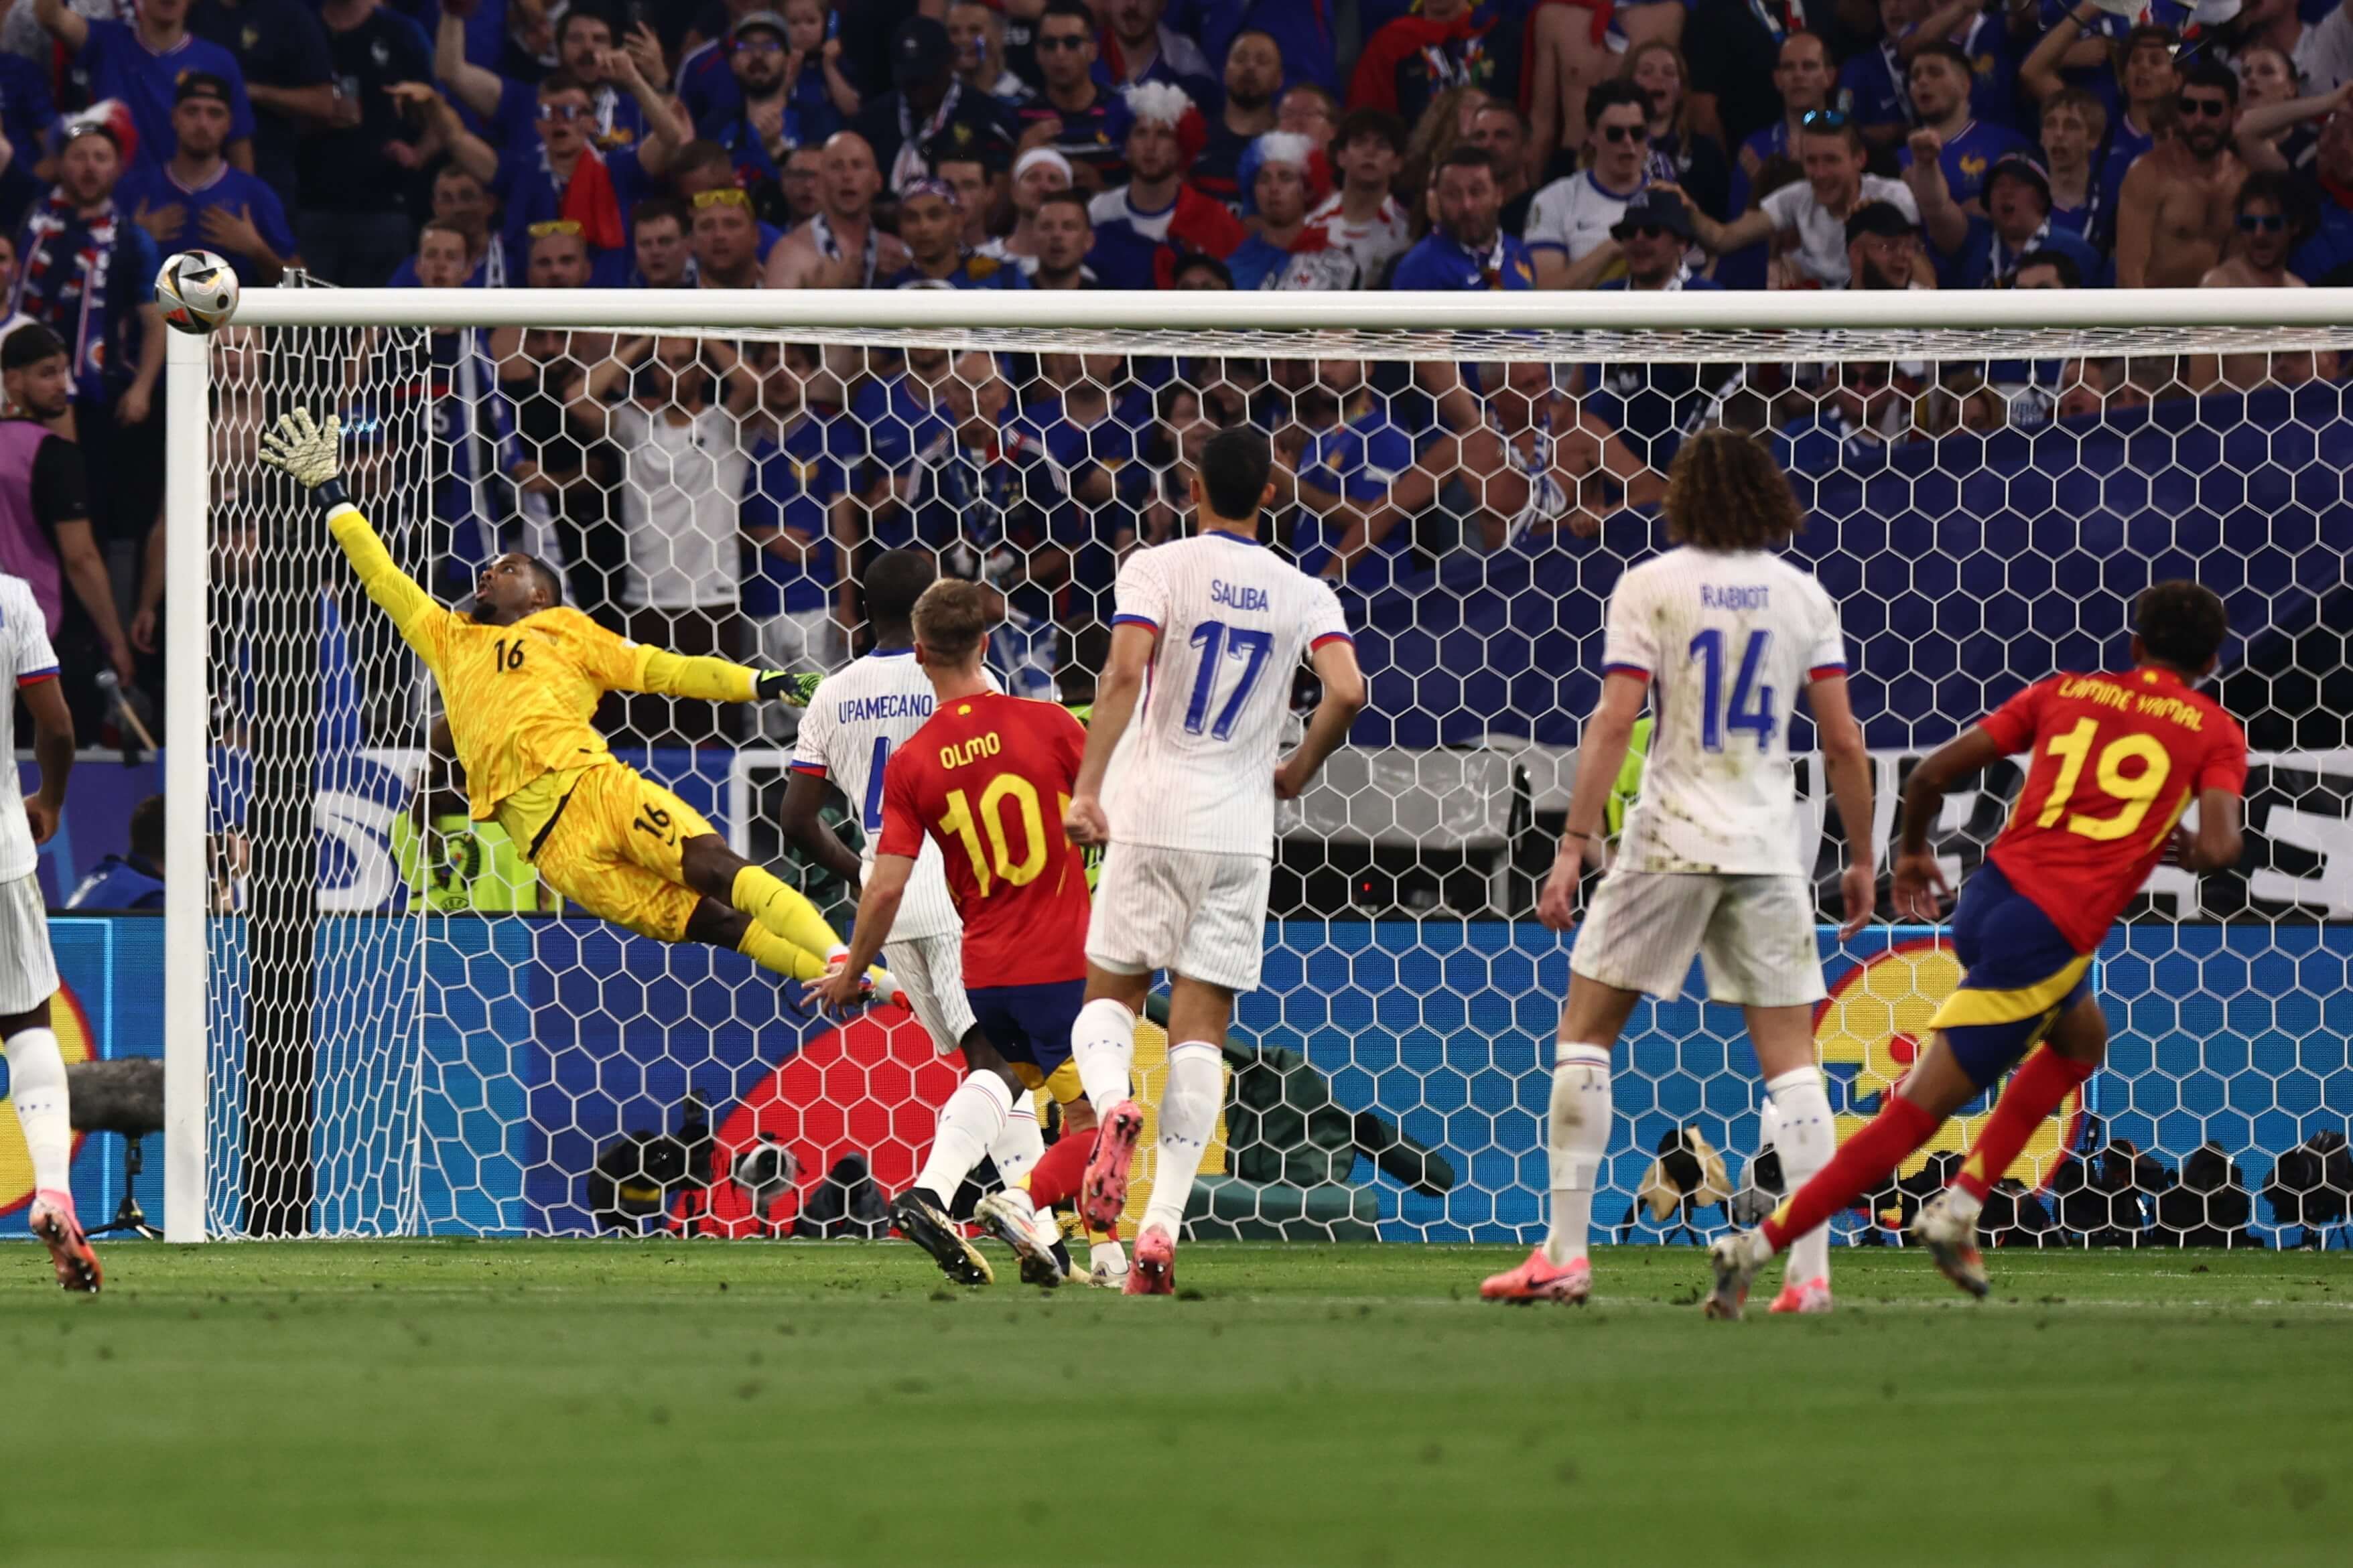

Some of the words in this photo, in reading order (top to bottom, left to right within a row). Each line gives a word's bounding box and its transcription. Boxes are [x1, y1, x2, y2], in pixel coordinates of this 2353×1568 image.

[1211, 579, 1269, 612] SALIBA
[1700, 584, 1769, 612] RABIOT
[494, 638, 525, 674] 16
[1185, 620, 1274, 742] 17
[1689, 628, 1780, 755] 14
[838, 694, 933, 725] UPAMECANO
[2058, 675, 2135, 712] LAMINE
[2136, 693, 2203, 733] YAMAL
[939, 731, 1002, 770] OLMO
[2036, 715, 2172, 841] 19
[633, 802, 670, 840] 16
[939, 773, 1048, 898] 10
